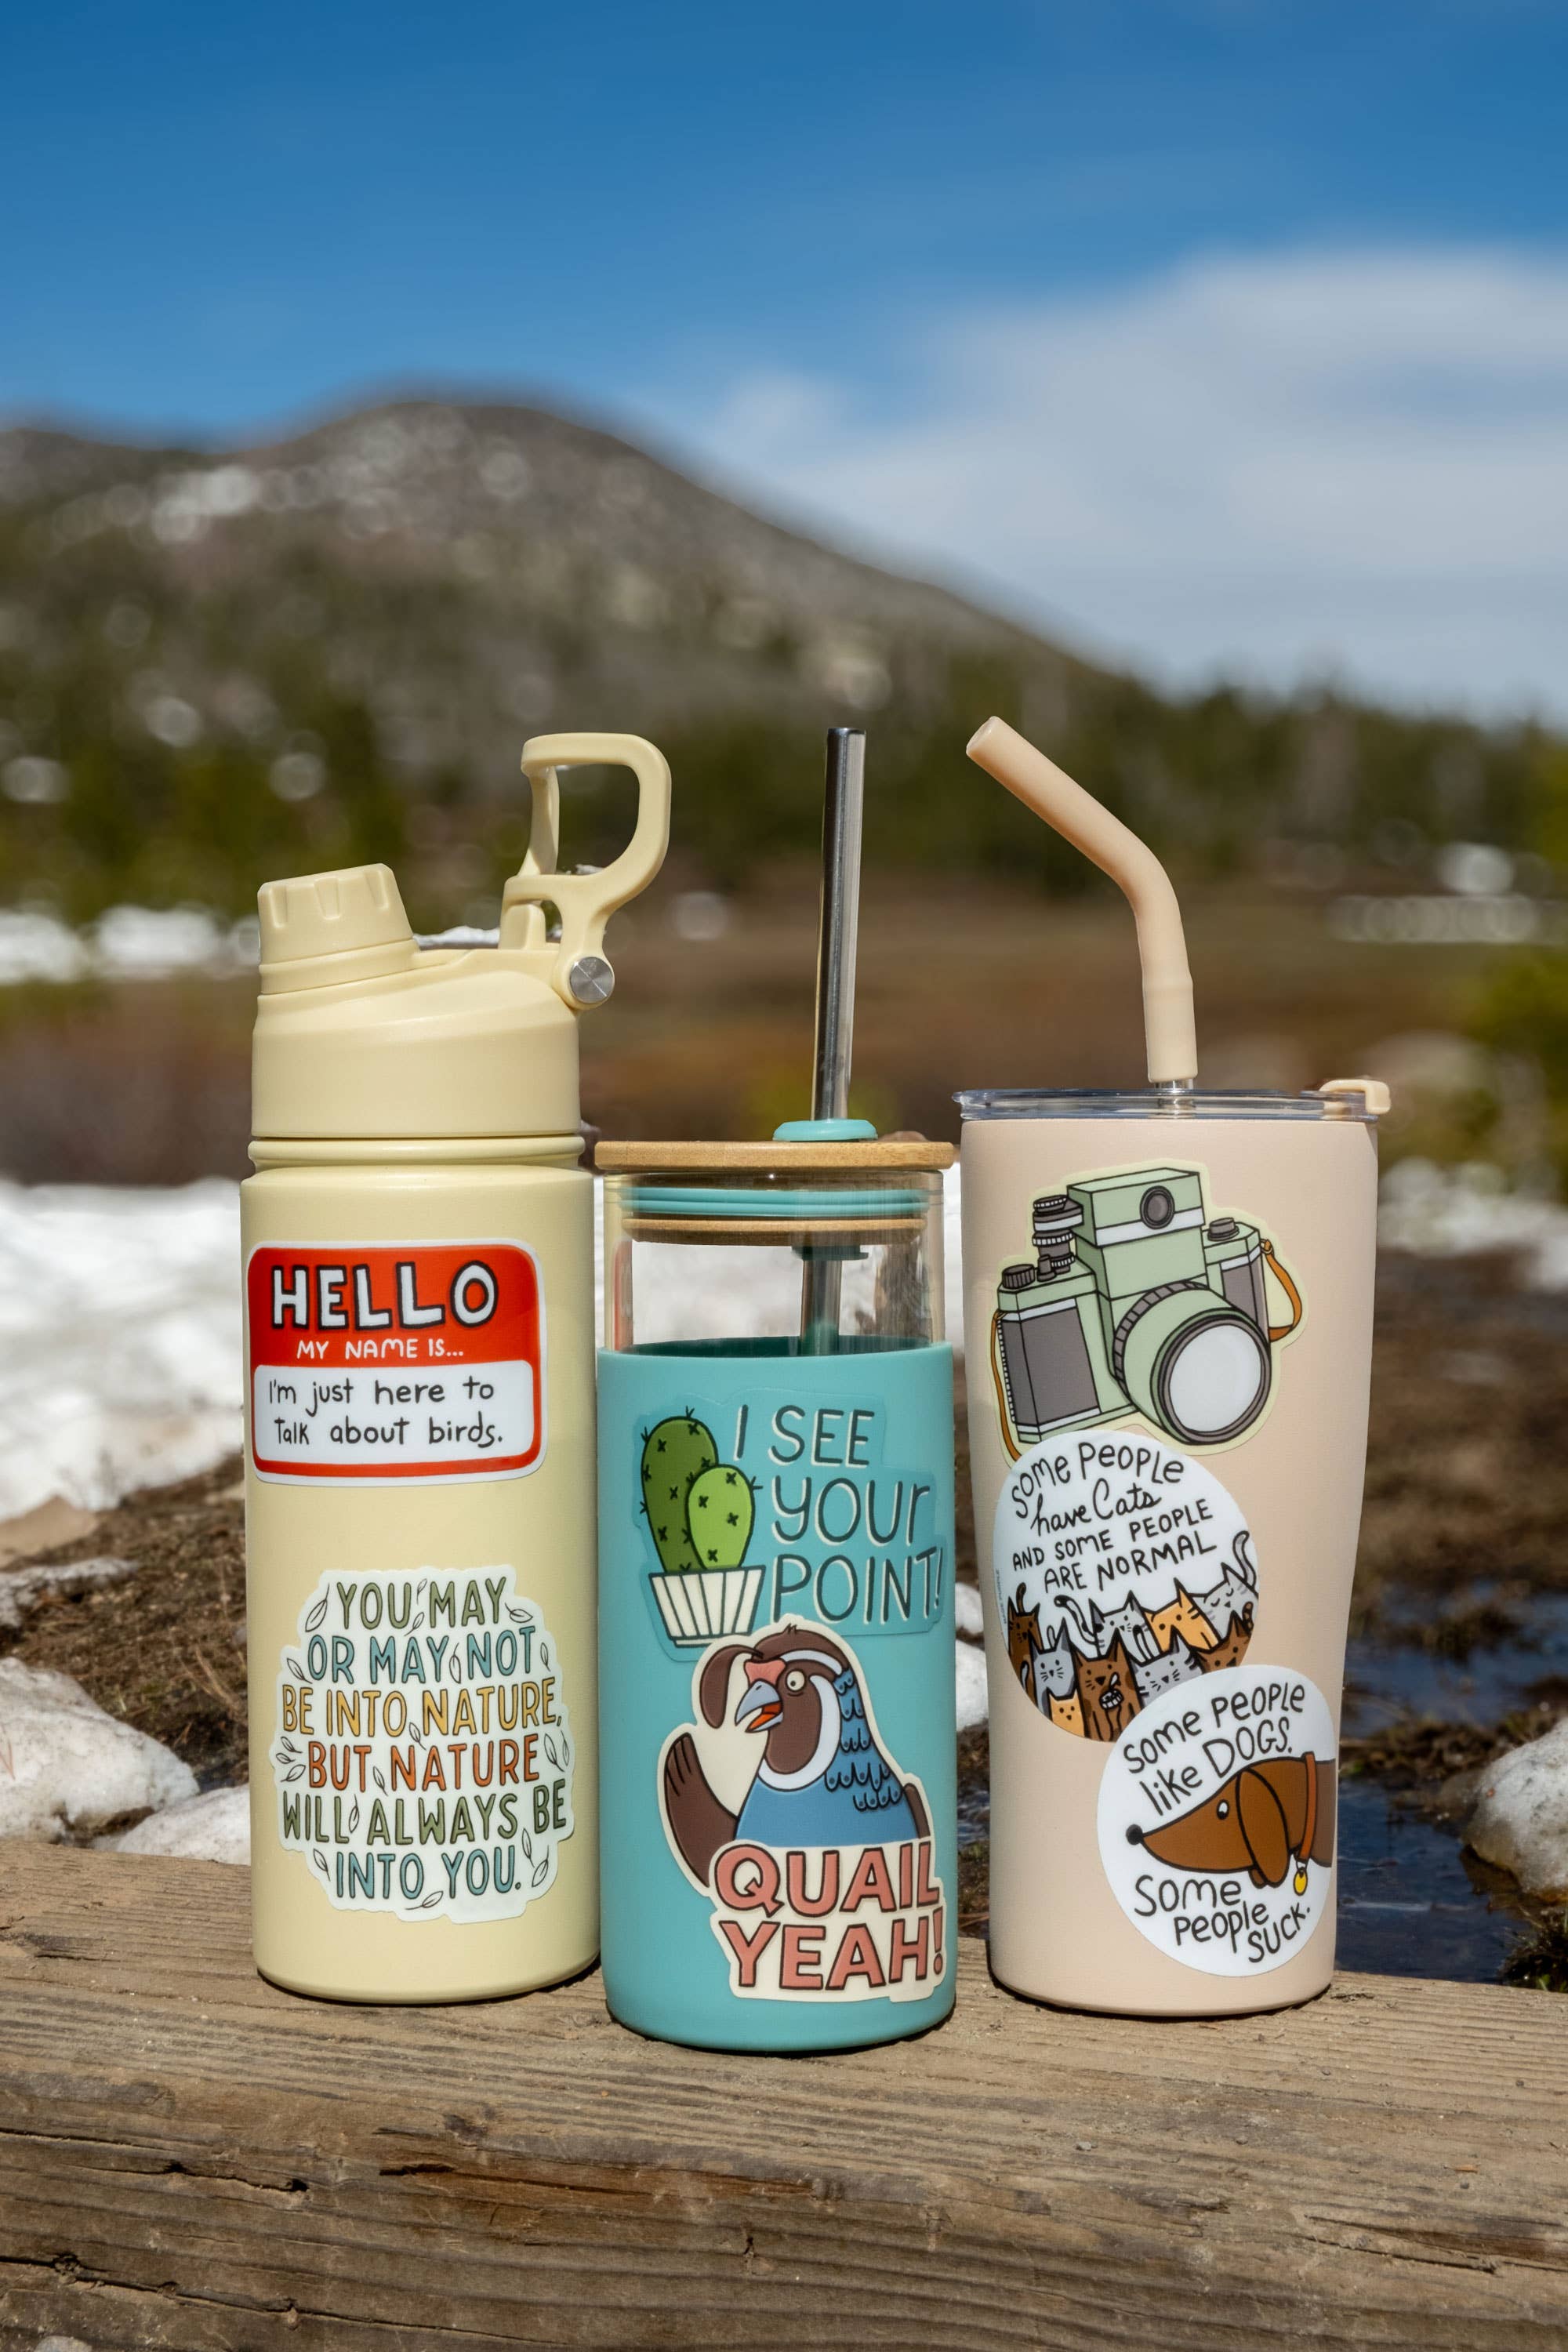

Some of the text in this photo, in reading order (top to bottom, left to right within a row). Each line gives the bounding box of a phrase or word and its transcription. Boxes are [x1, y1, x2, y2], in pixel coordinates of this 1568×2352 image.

[271, 1260, 499, 1330] HELLO
[296, 1338, 464, 1359] MY NAME IS...
[269, 1375, 494, 1417] I'm just here to
[329, 1416, 410, 1444] about
[429, 1411, 503, 1449] birds.
[733, 1404, 875, 1468] I SEE
[1012, 1498, 1214, 1571] AND SOME PEOPLE
[1030, 1478, 1162, 1537] have Cats
[770, 1546, 942, 1625] POINT!
[1044, 1530, 1217, 1593] ARE NORMAL
[336, 1577, 507, 1630] YOU MAY
[307, 1626, 536, 1685] OR MAY NOT
[282, 1676, 562, 1737] BE INTO NATURE,
[308, 1733, 539, 1792] BUT NATURE
[1202, 1717, 1293, 1778] DOGS.
[283, 1778, 567, 1846] WILL ALWAYS BE
[336, 1845, 521, 1900] INTO YOU.
[713, 1840, 942, 1918] QUAIL
[1134, 1875, 1242, 1917] Some
[718, 1905, 944, 1991] YEAH!
